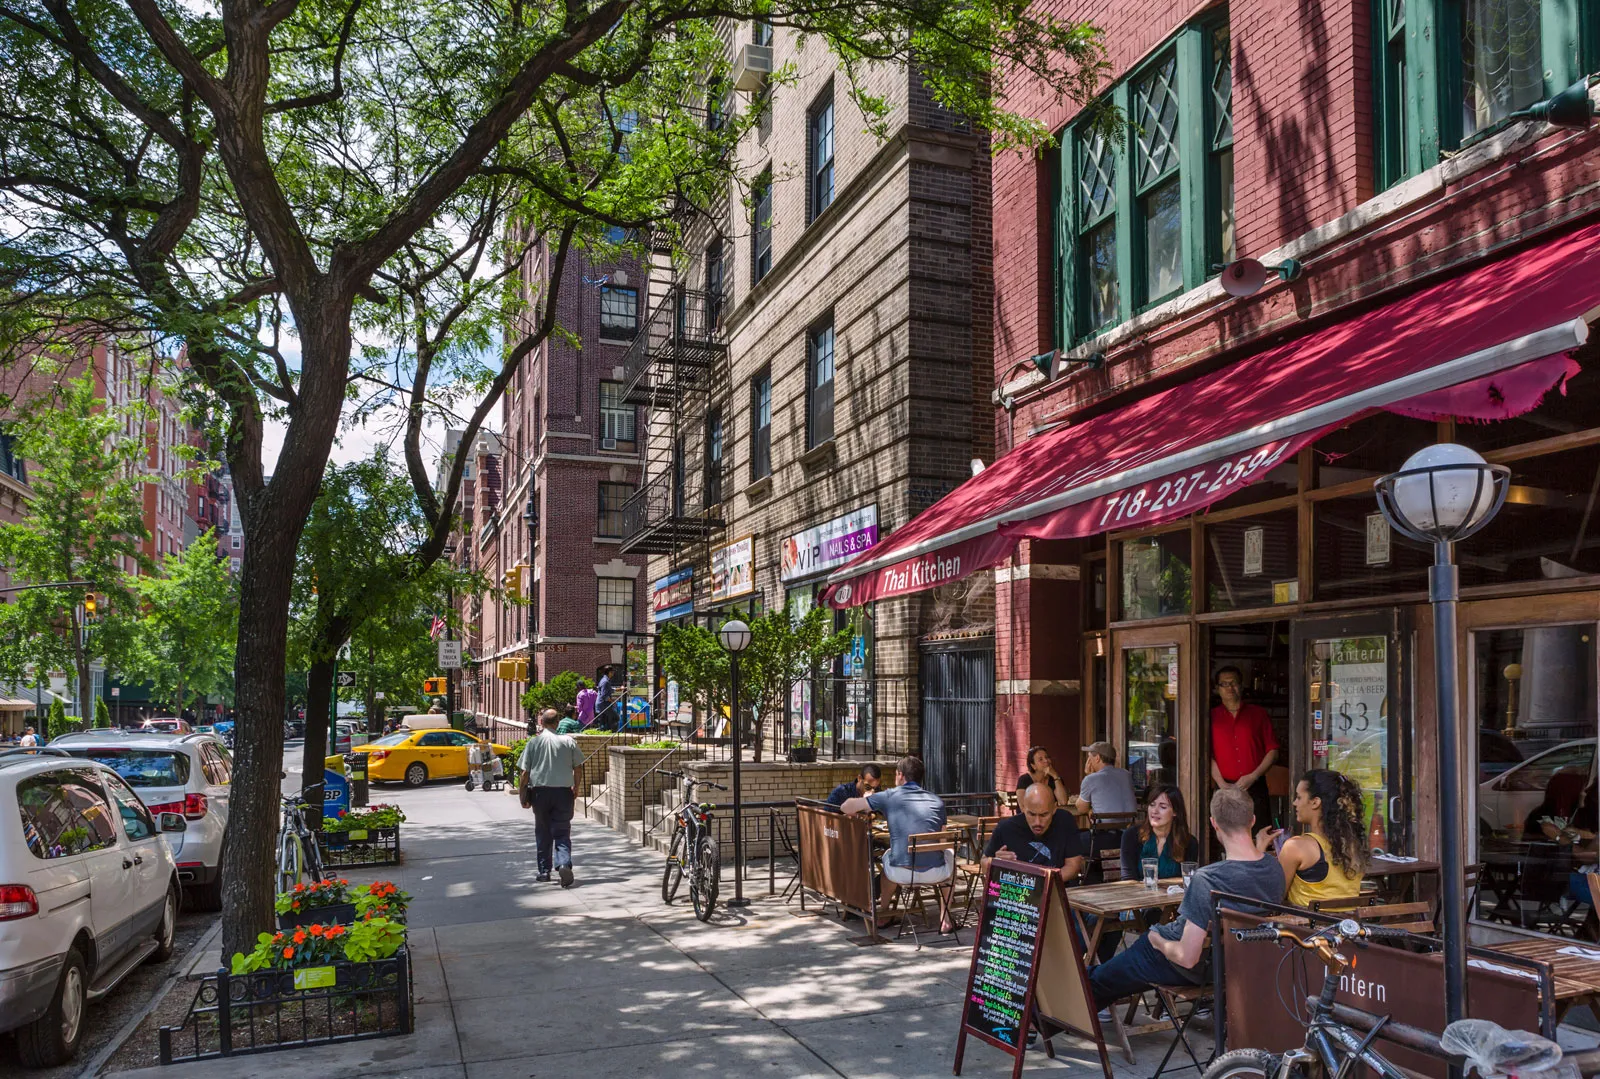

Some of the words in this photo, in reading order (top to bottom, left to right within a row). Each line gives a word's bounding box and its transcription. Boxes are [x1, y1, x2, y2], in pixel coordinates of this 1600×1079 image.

[1100, 441, 1290, 526] 718-237-2594
[829, 537, 849, 557] NAILS
[850, 537, 856, 551] &
[856, 531, 872, 549] SPA
[883, 564, 909, 593] Thai
[911, 555, 961, 587] Kitchen
[557, 643, 564, 652] ST
[1332, 648, 1384, 662] lantern
[1366, 684, 1385, 694] BEER
[1339, 699, 1369, 736] $3
[1324, 964, 1386, 1003] lntern
